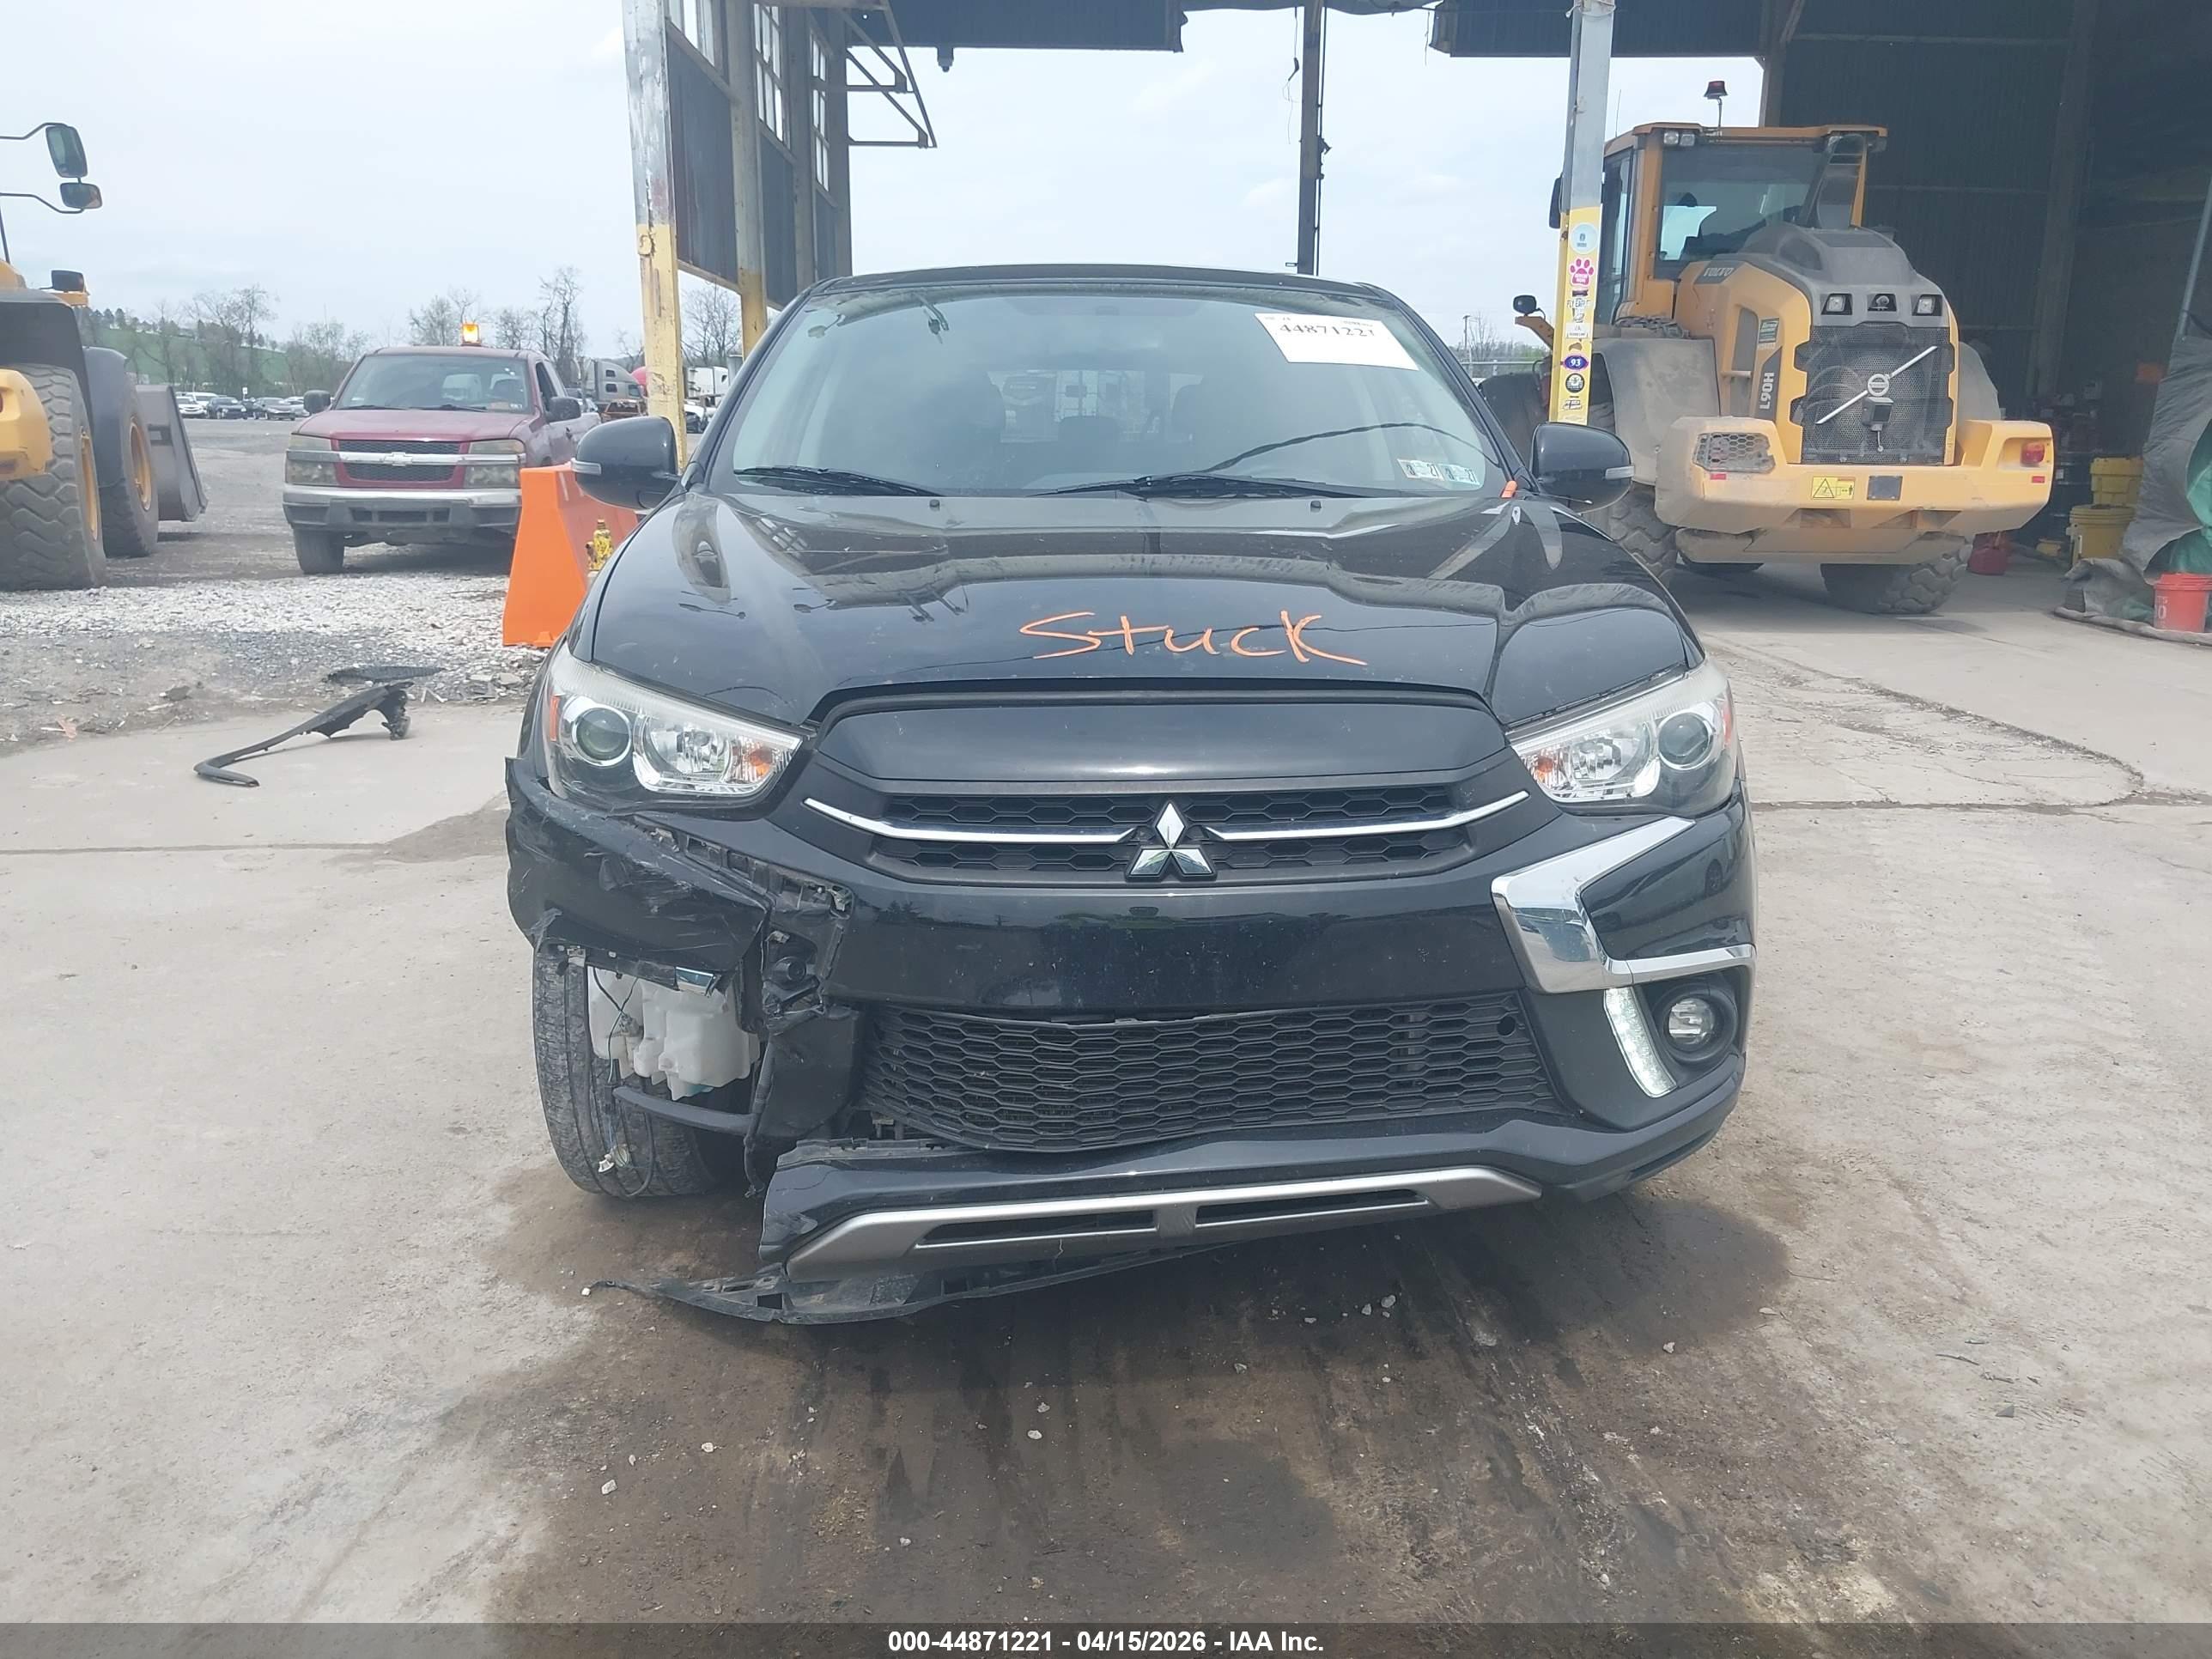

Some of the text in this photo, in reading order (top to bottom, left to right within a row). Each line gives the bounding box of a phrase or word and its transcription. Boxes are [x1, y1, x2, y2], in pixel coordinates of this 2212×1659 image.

[1279, 324, 1375, 337] 44871221
[1570, 358, 1581, 368] 93
[1759, 372, 1775, 410] L90H
